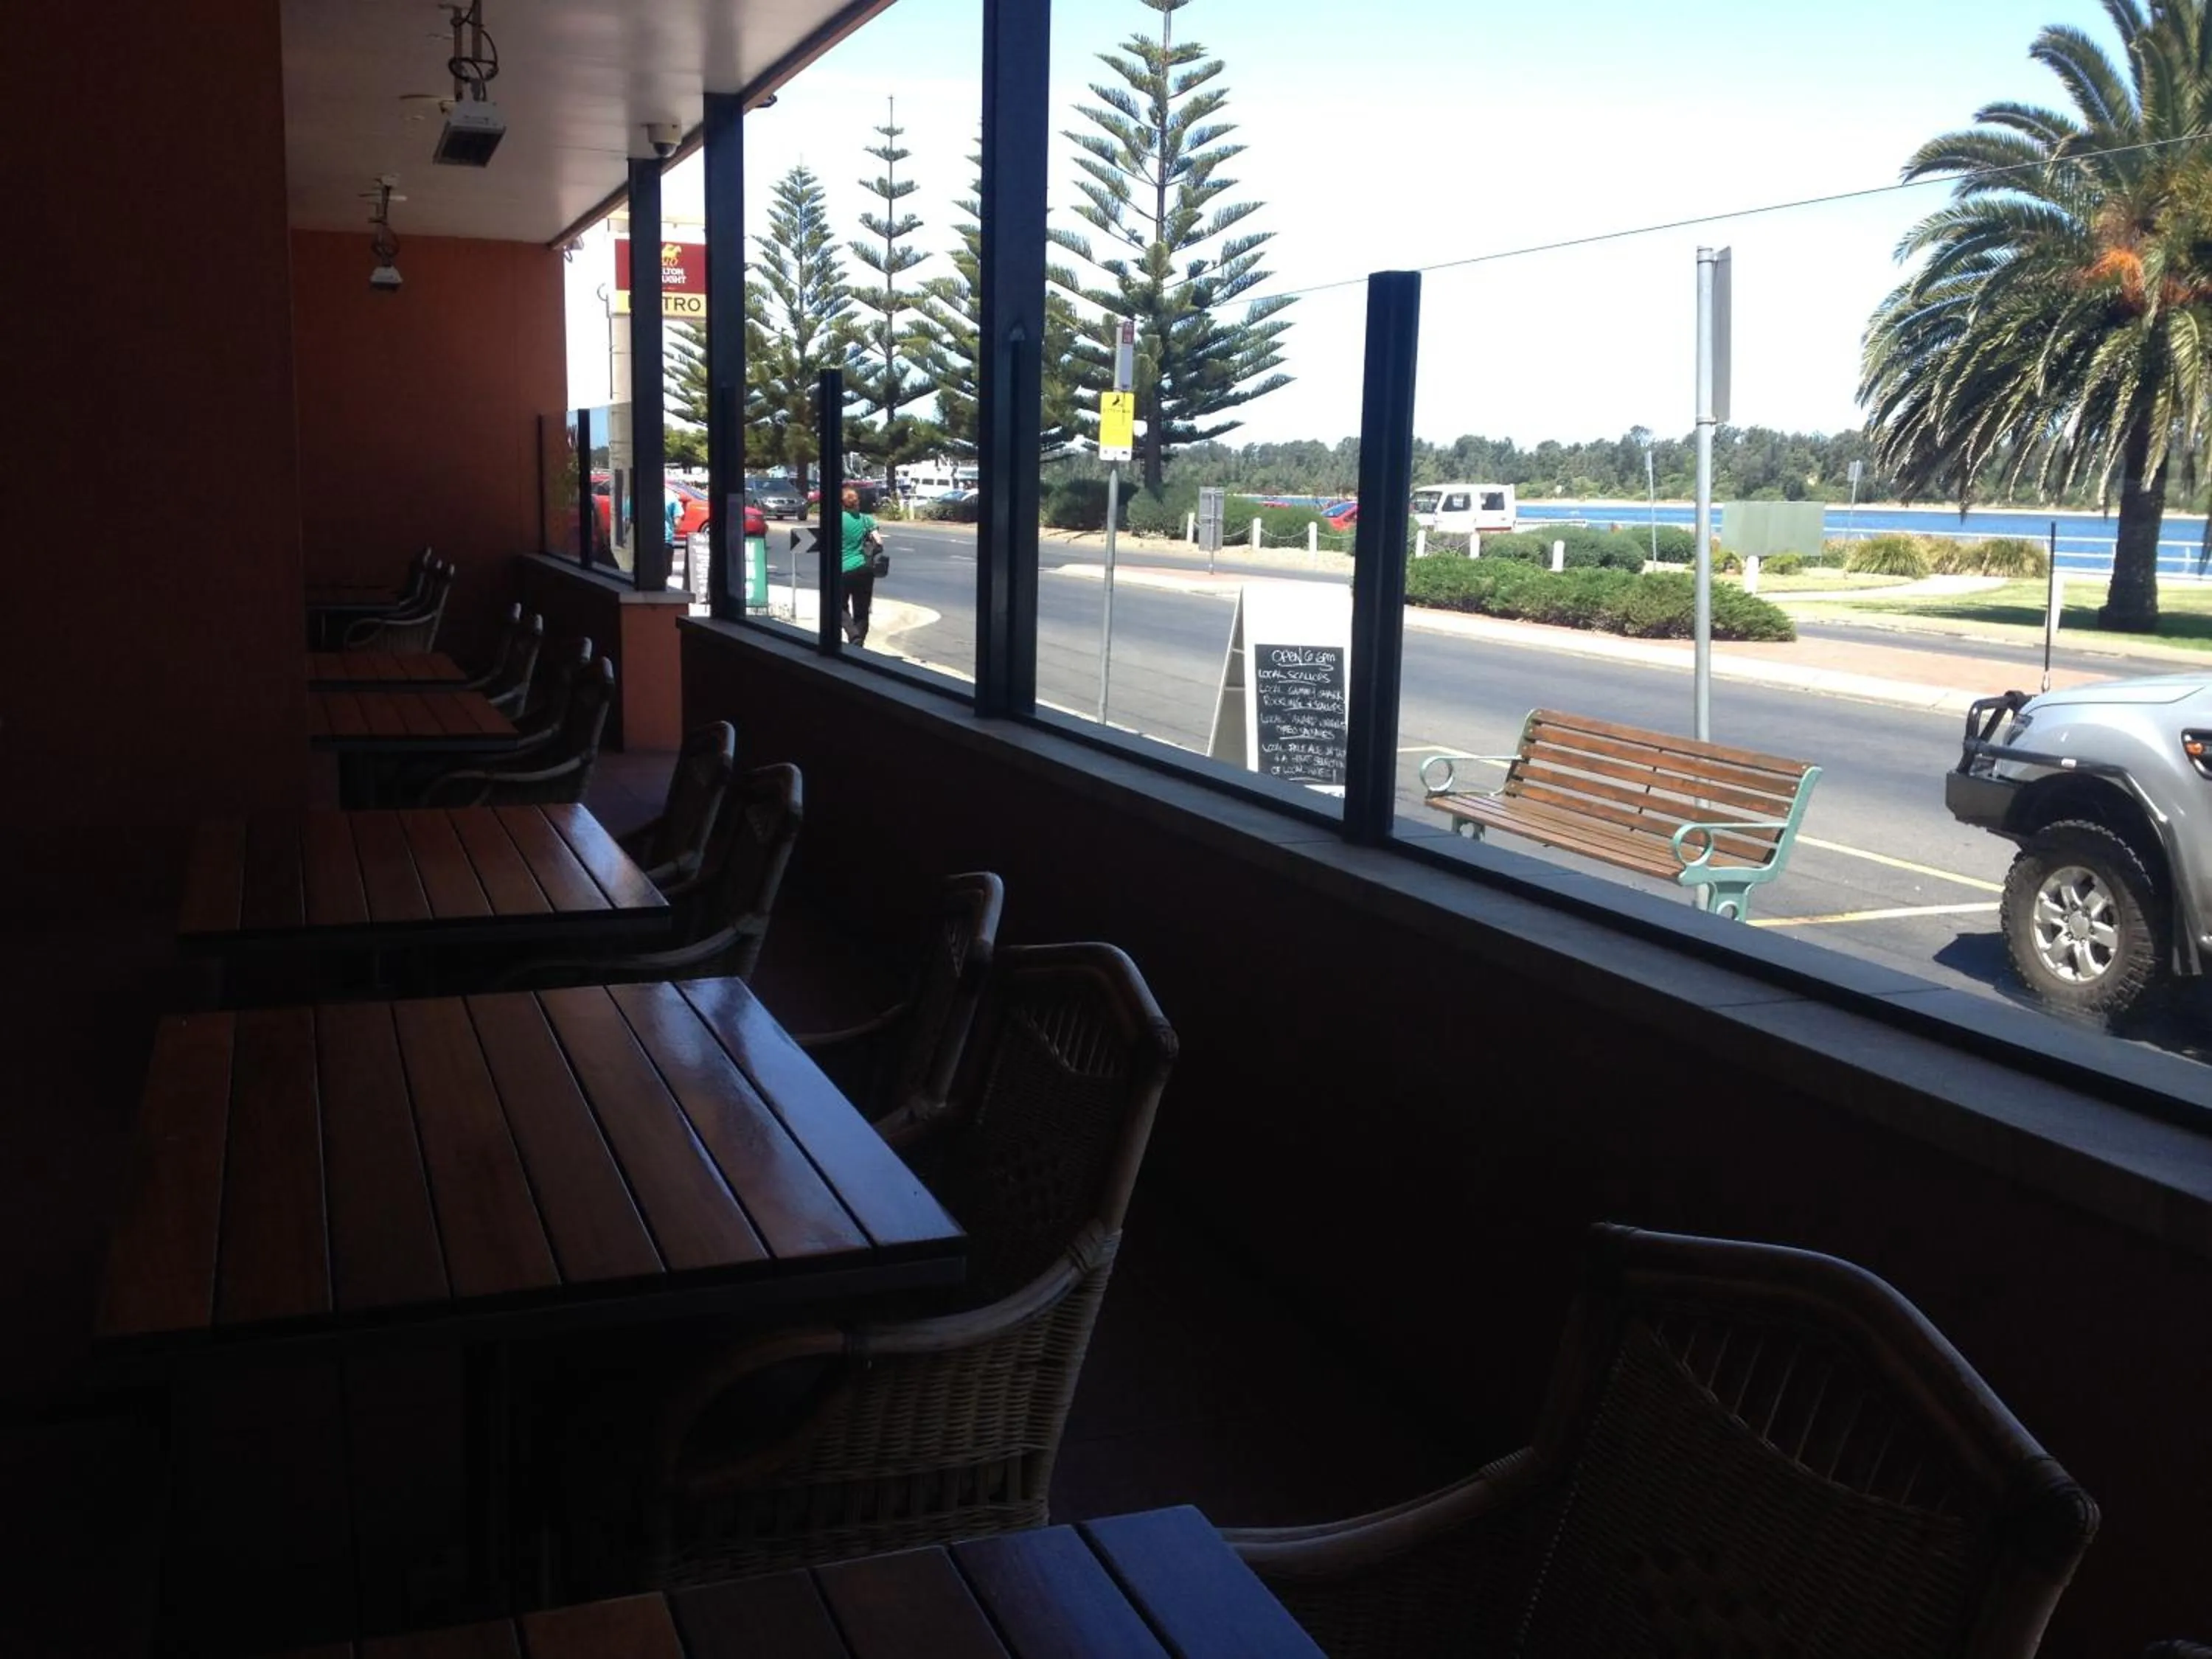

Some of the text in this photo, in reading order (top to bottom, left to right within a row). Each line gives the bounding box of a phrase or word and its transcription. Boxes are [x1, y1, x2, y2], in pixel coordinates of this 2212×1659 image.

[662, 276, 686, 284] UGHT
[662, 297, 701, 312] TRO
[1271, 647, 1302, 664] OPEN
[1258, 668, 1287, 679] LOCAL
